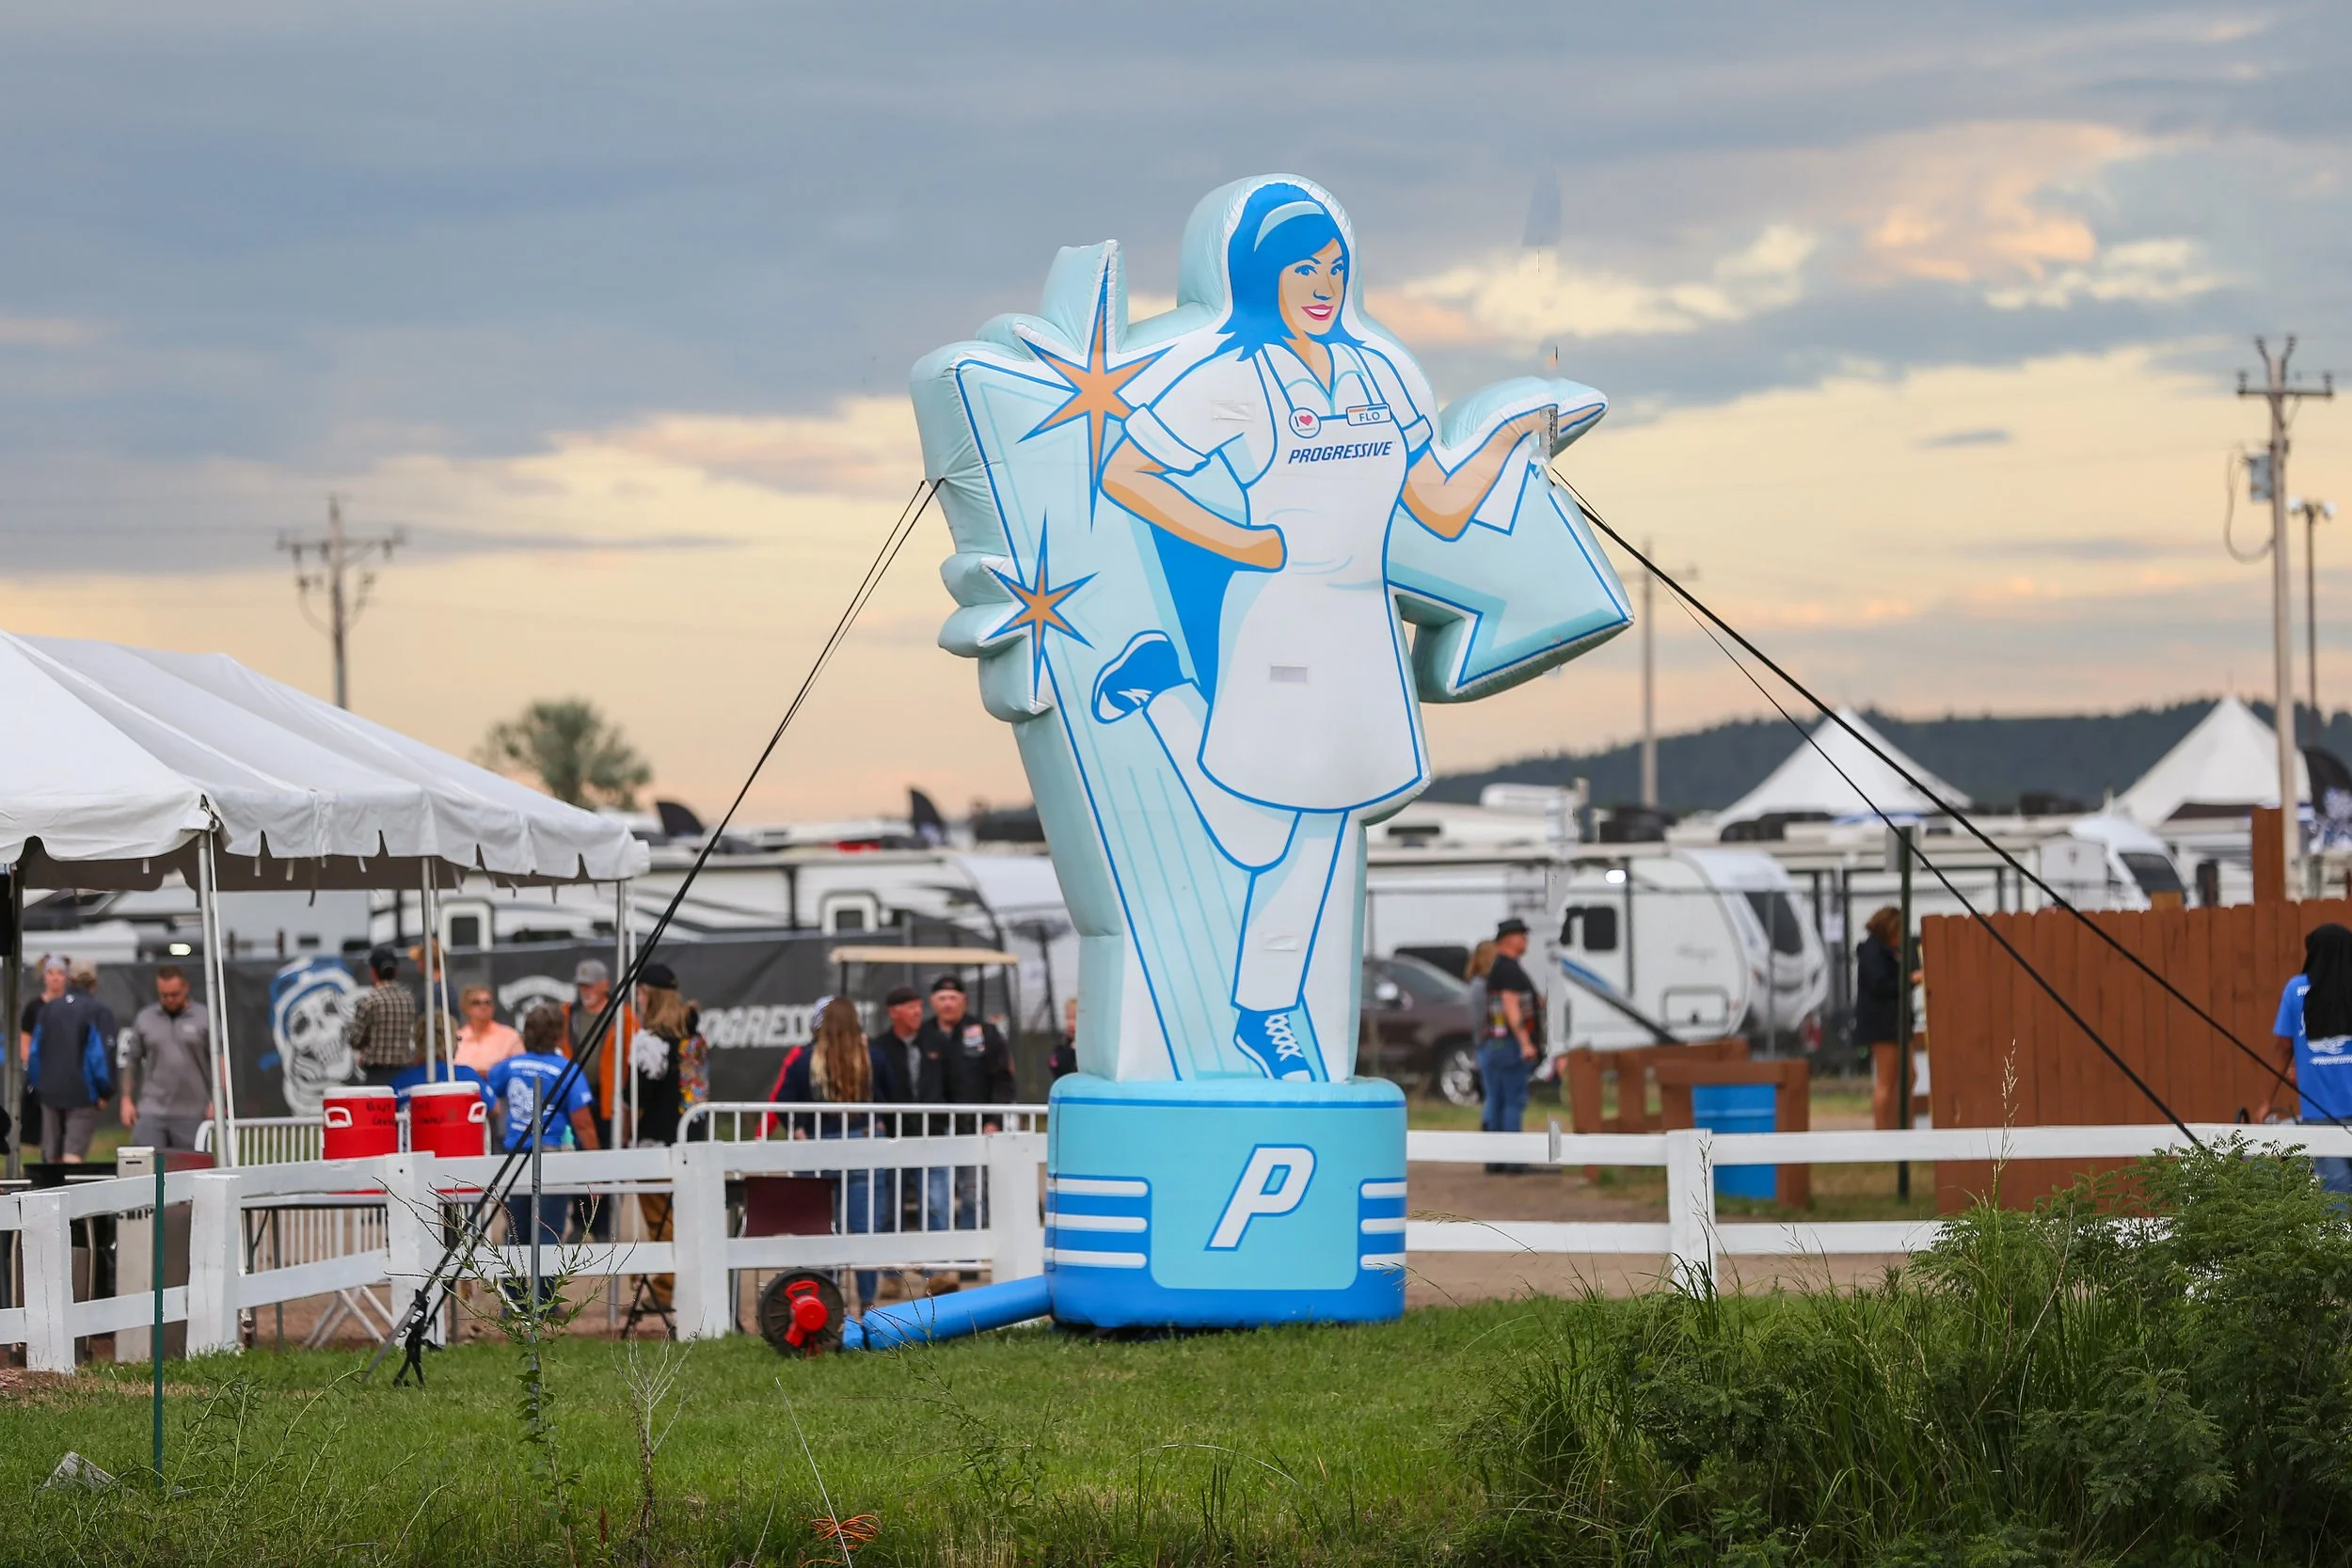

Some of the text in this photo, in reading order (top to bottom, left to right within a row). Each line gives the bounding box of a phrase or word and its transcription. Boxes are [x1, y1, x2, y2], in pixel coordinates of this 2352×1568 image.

[1294, 416, 1299, 427] I
[1359, 412, 1379, 422] FLO
[1288, 441, 1392, 464] PROGRESSIVE
[1204, 1144, 1317, 1251] P
